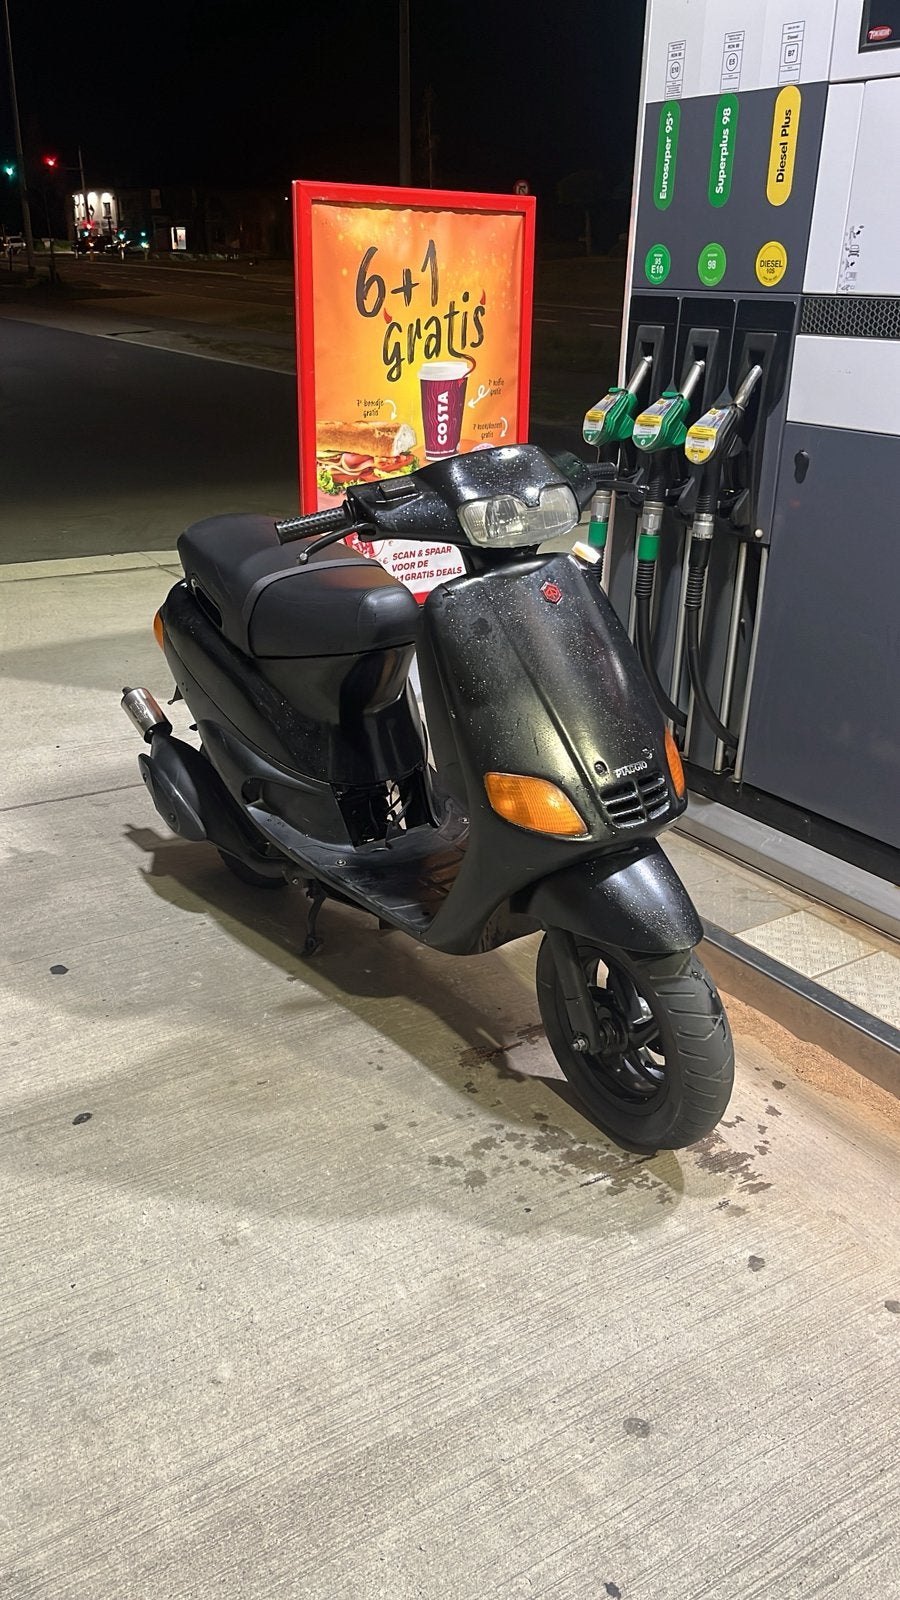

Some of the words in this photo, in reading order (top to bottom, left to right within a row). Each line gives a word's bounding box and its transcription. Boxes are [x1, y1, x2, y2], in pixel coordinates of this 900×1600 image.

[665, 111, 674, 133] 95+
[721, 107, 732, 124] 98
[780, 109, 792, 137] Plus
[659, 136, 673, 200] Eurosuper
[715, 128, 730, 194] Superplus
[775, 141, 788, 183] Diesel
[650, 264, 664, 274] E10
[707, 260, 717, 270] 98
[759, 260, 783, 268] DIESEL
[356, 239, 439, 318] 6+1
[382, 291, 486, 383] gratis
[363, 409, 379, 418] gratis
[437, 391, 449, 445] COSTA
[392, 550, 416, 560] SCAN
[417, 548, 423, 557] &
[424, 545, 452, 556] SPAAR
[391, 562, 416, 572] VOOR
[417, 559, 429, 568] DE
[436, 566, 463, 576] DEALS
[613, 760, 648, 779] PIAGGIO
